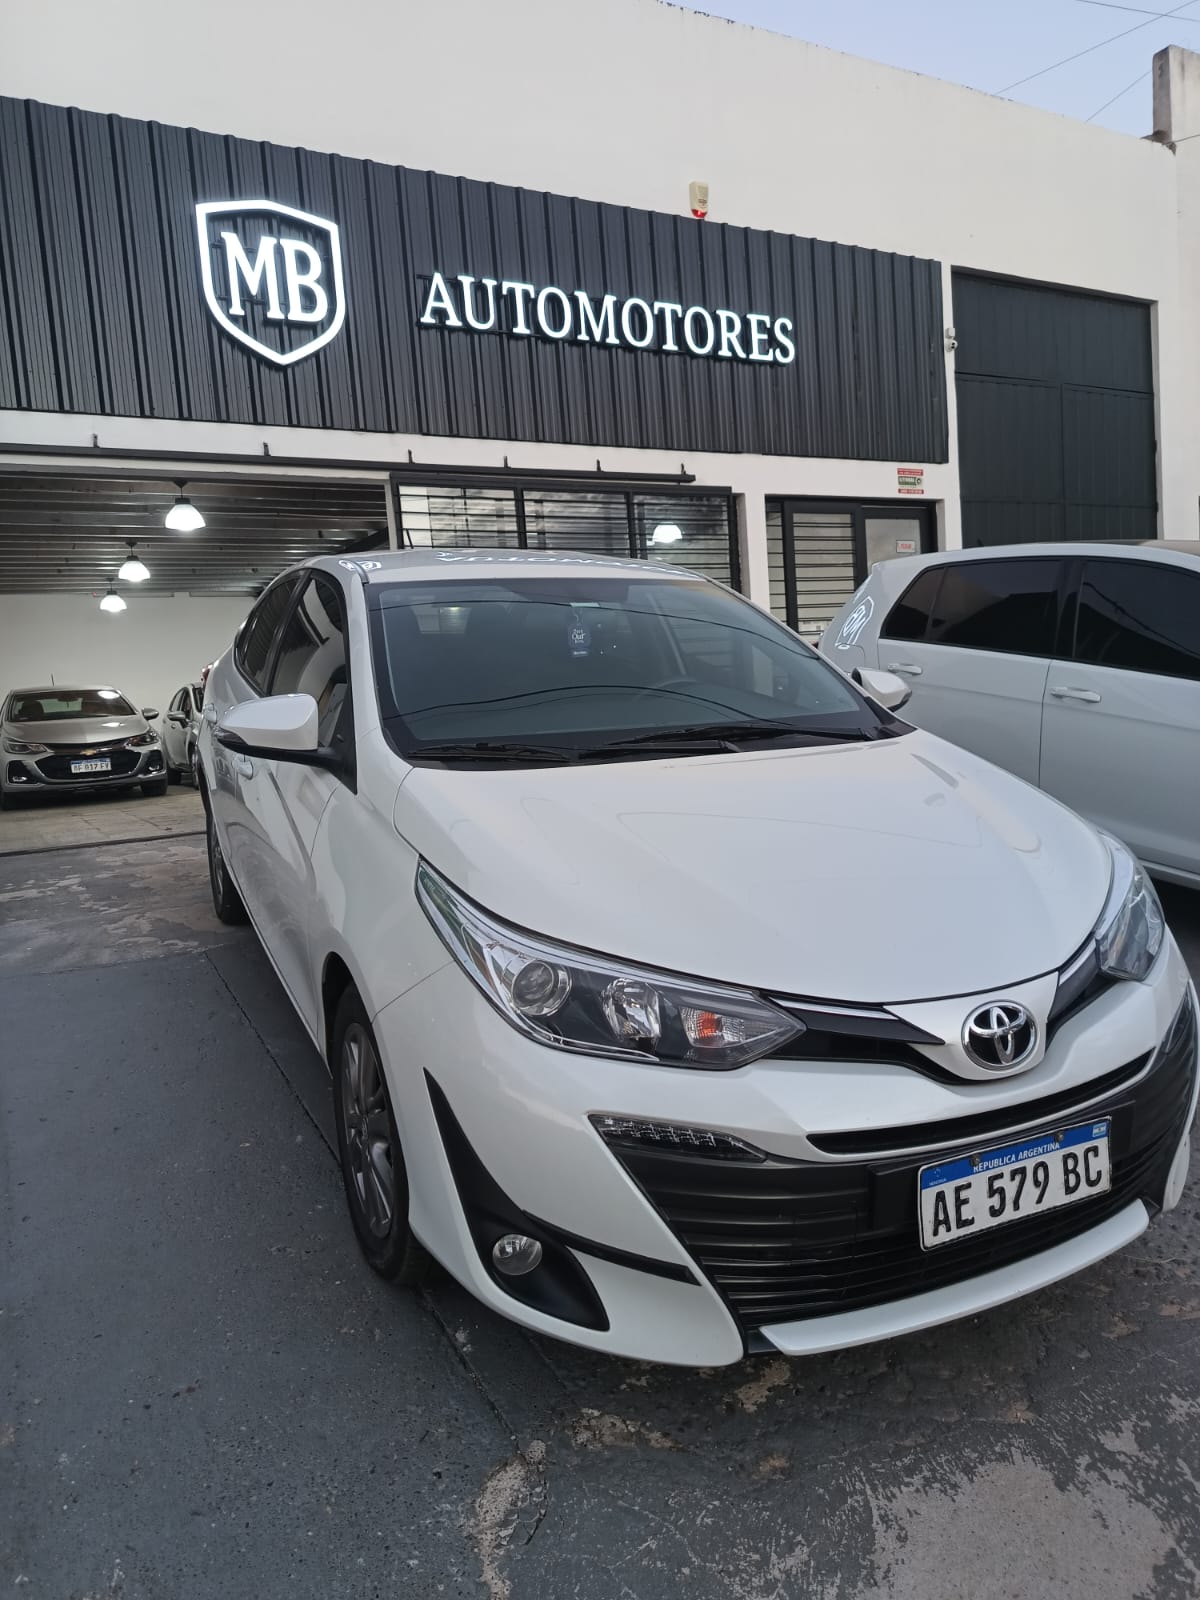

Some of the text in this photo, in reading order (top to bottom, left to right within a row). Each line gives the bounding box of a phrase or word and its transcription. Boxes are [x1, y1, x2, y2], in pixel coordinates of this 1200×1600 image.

[221, 231, 328, 322] MB
[420, 272, 795, 363] AUTOMOTORES
[932, 1145, 1103, 1237] AE 579 BC
[1017, 1142, 1060, 1161] ARGENTINA
